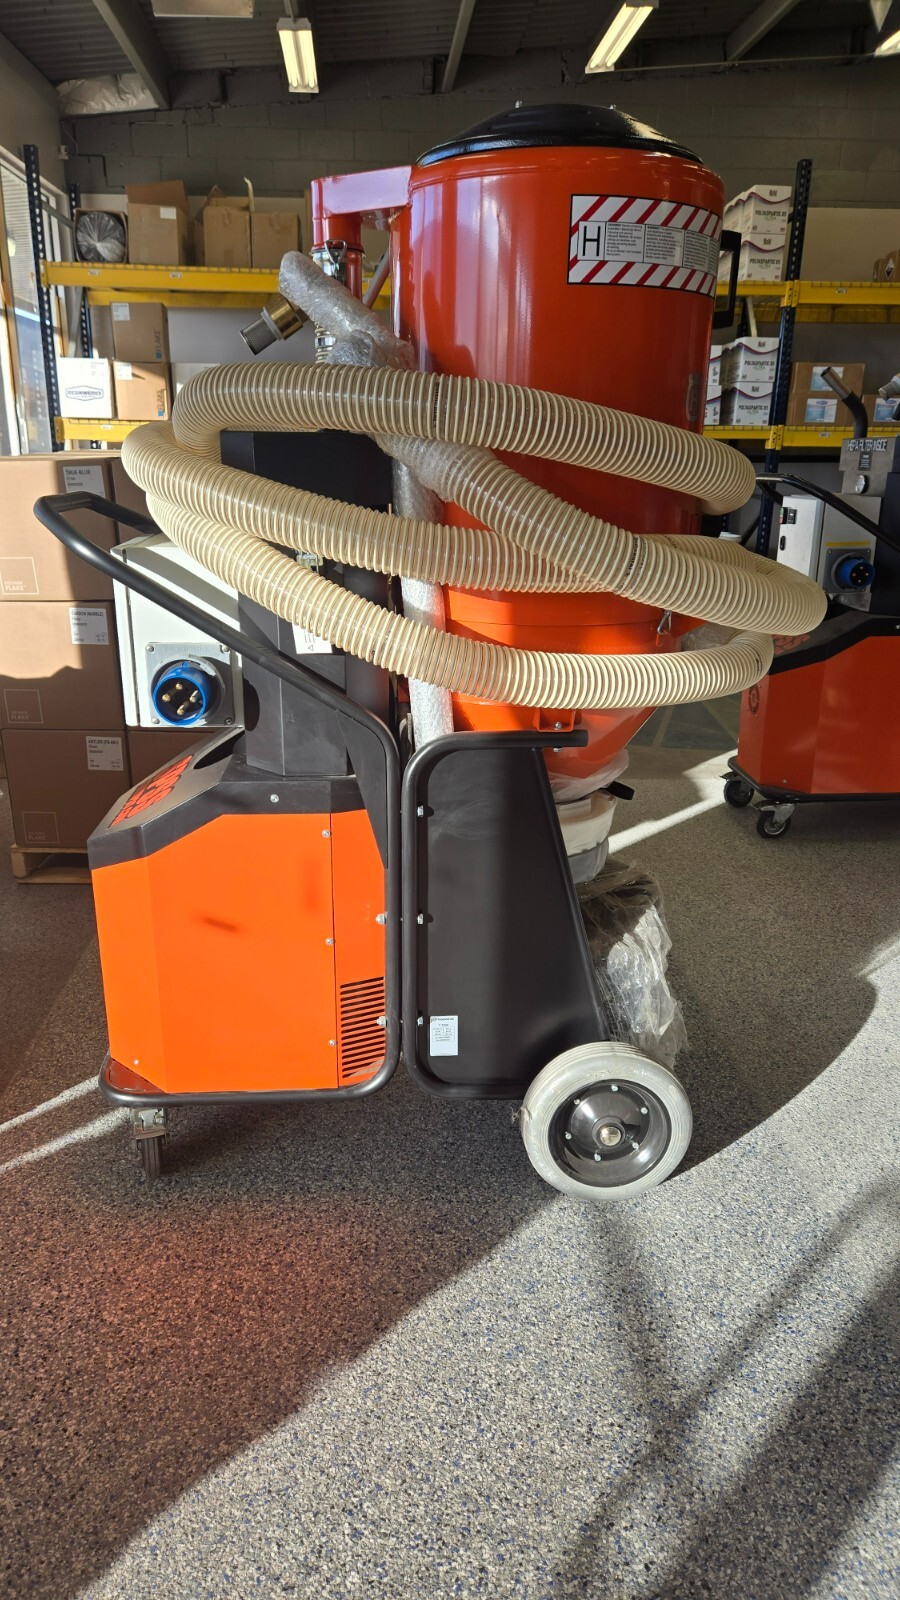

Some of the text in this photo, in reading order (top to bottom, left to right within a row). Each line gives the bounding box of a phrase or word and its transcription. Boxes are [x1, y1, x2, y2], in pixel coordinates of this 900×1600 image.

[582, 225, 601, 257] H
[156, 388, 164, 410] FLAKE
[847, 440, 858, 451] HEPA
[859, 439, 873, 451] FILTER
